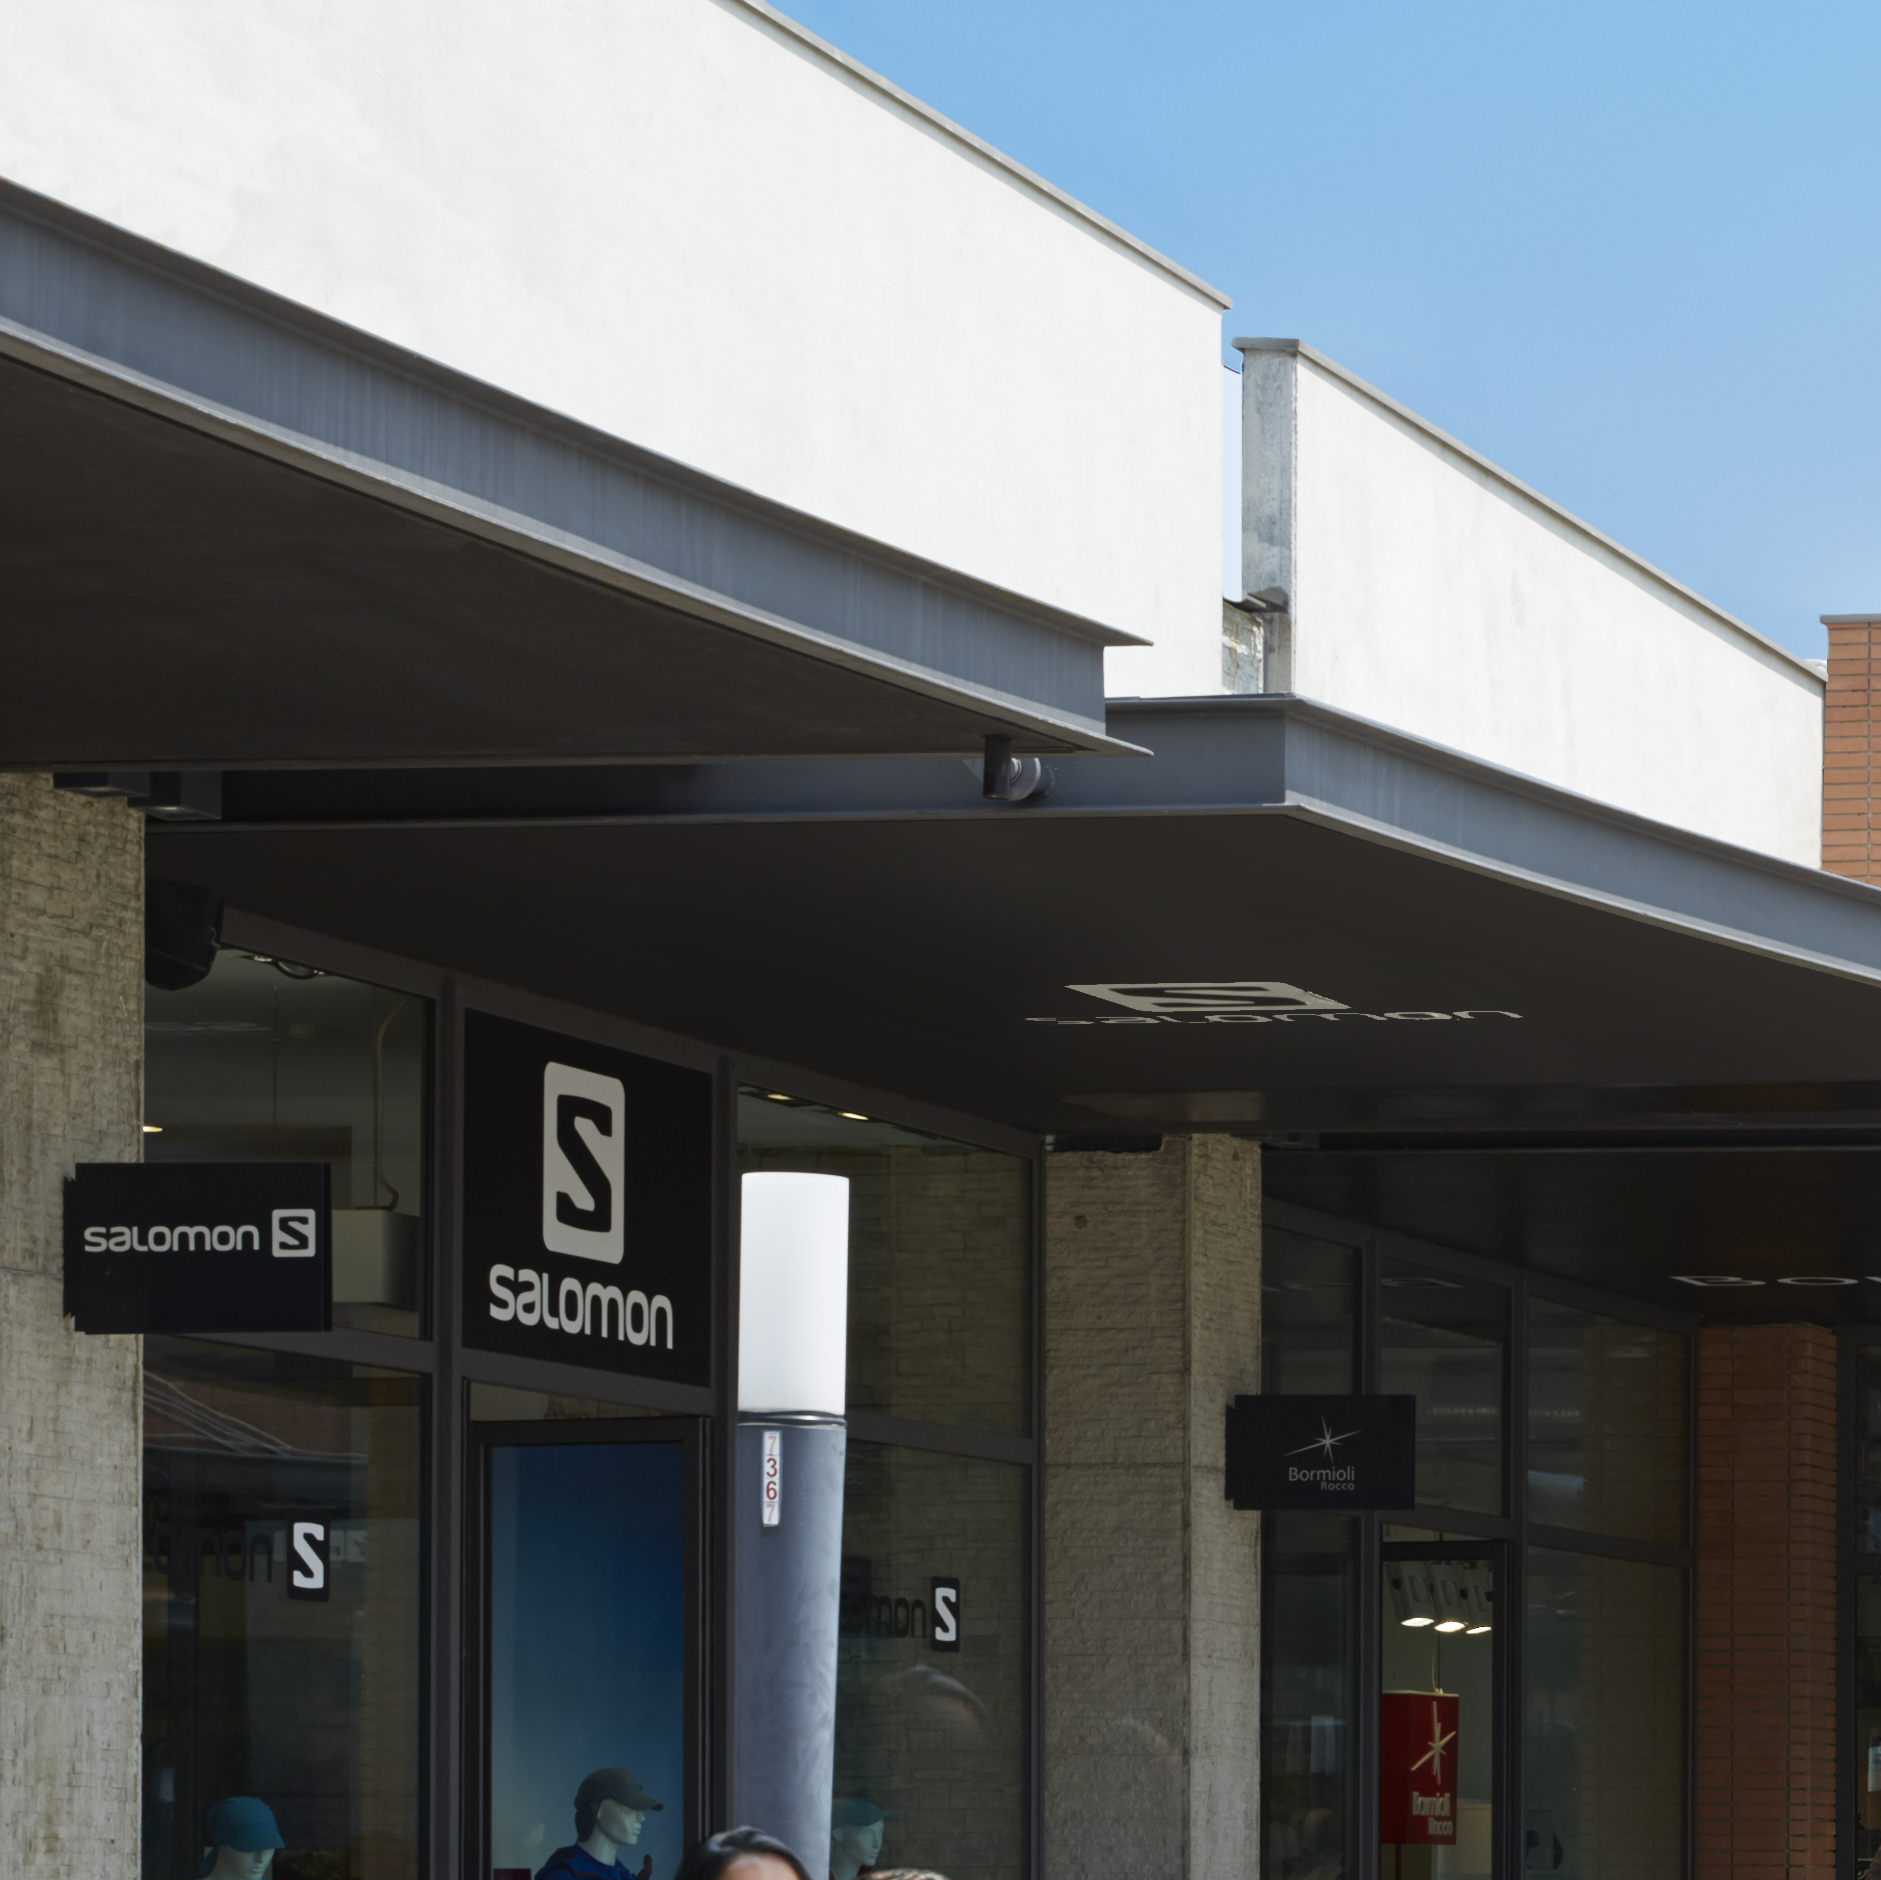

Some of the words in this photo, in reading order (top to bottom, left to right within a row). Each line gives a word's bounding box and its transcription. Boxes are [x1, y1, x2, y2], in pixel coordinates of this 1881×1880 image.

[83, 1224, 260, 1253] salomon
[489, 1263, 674, 1350] salomon
[1288, 1466, 1355, 1481] Bormioli
[1320, 1481, 1355, 1491] Rocco
